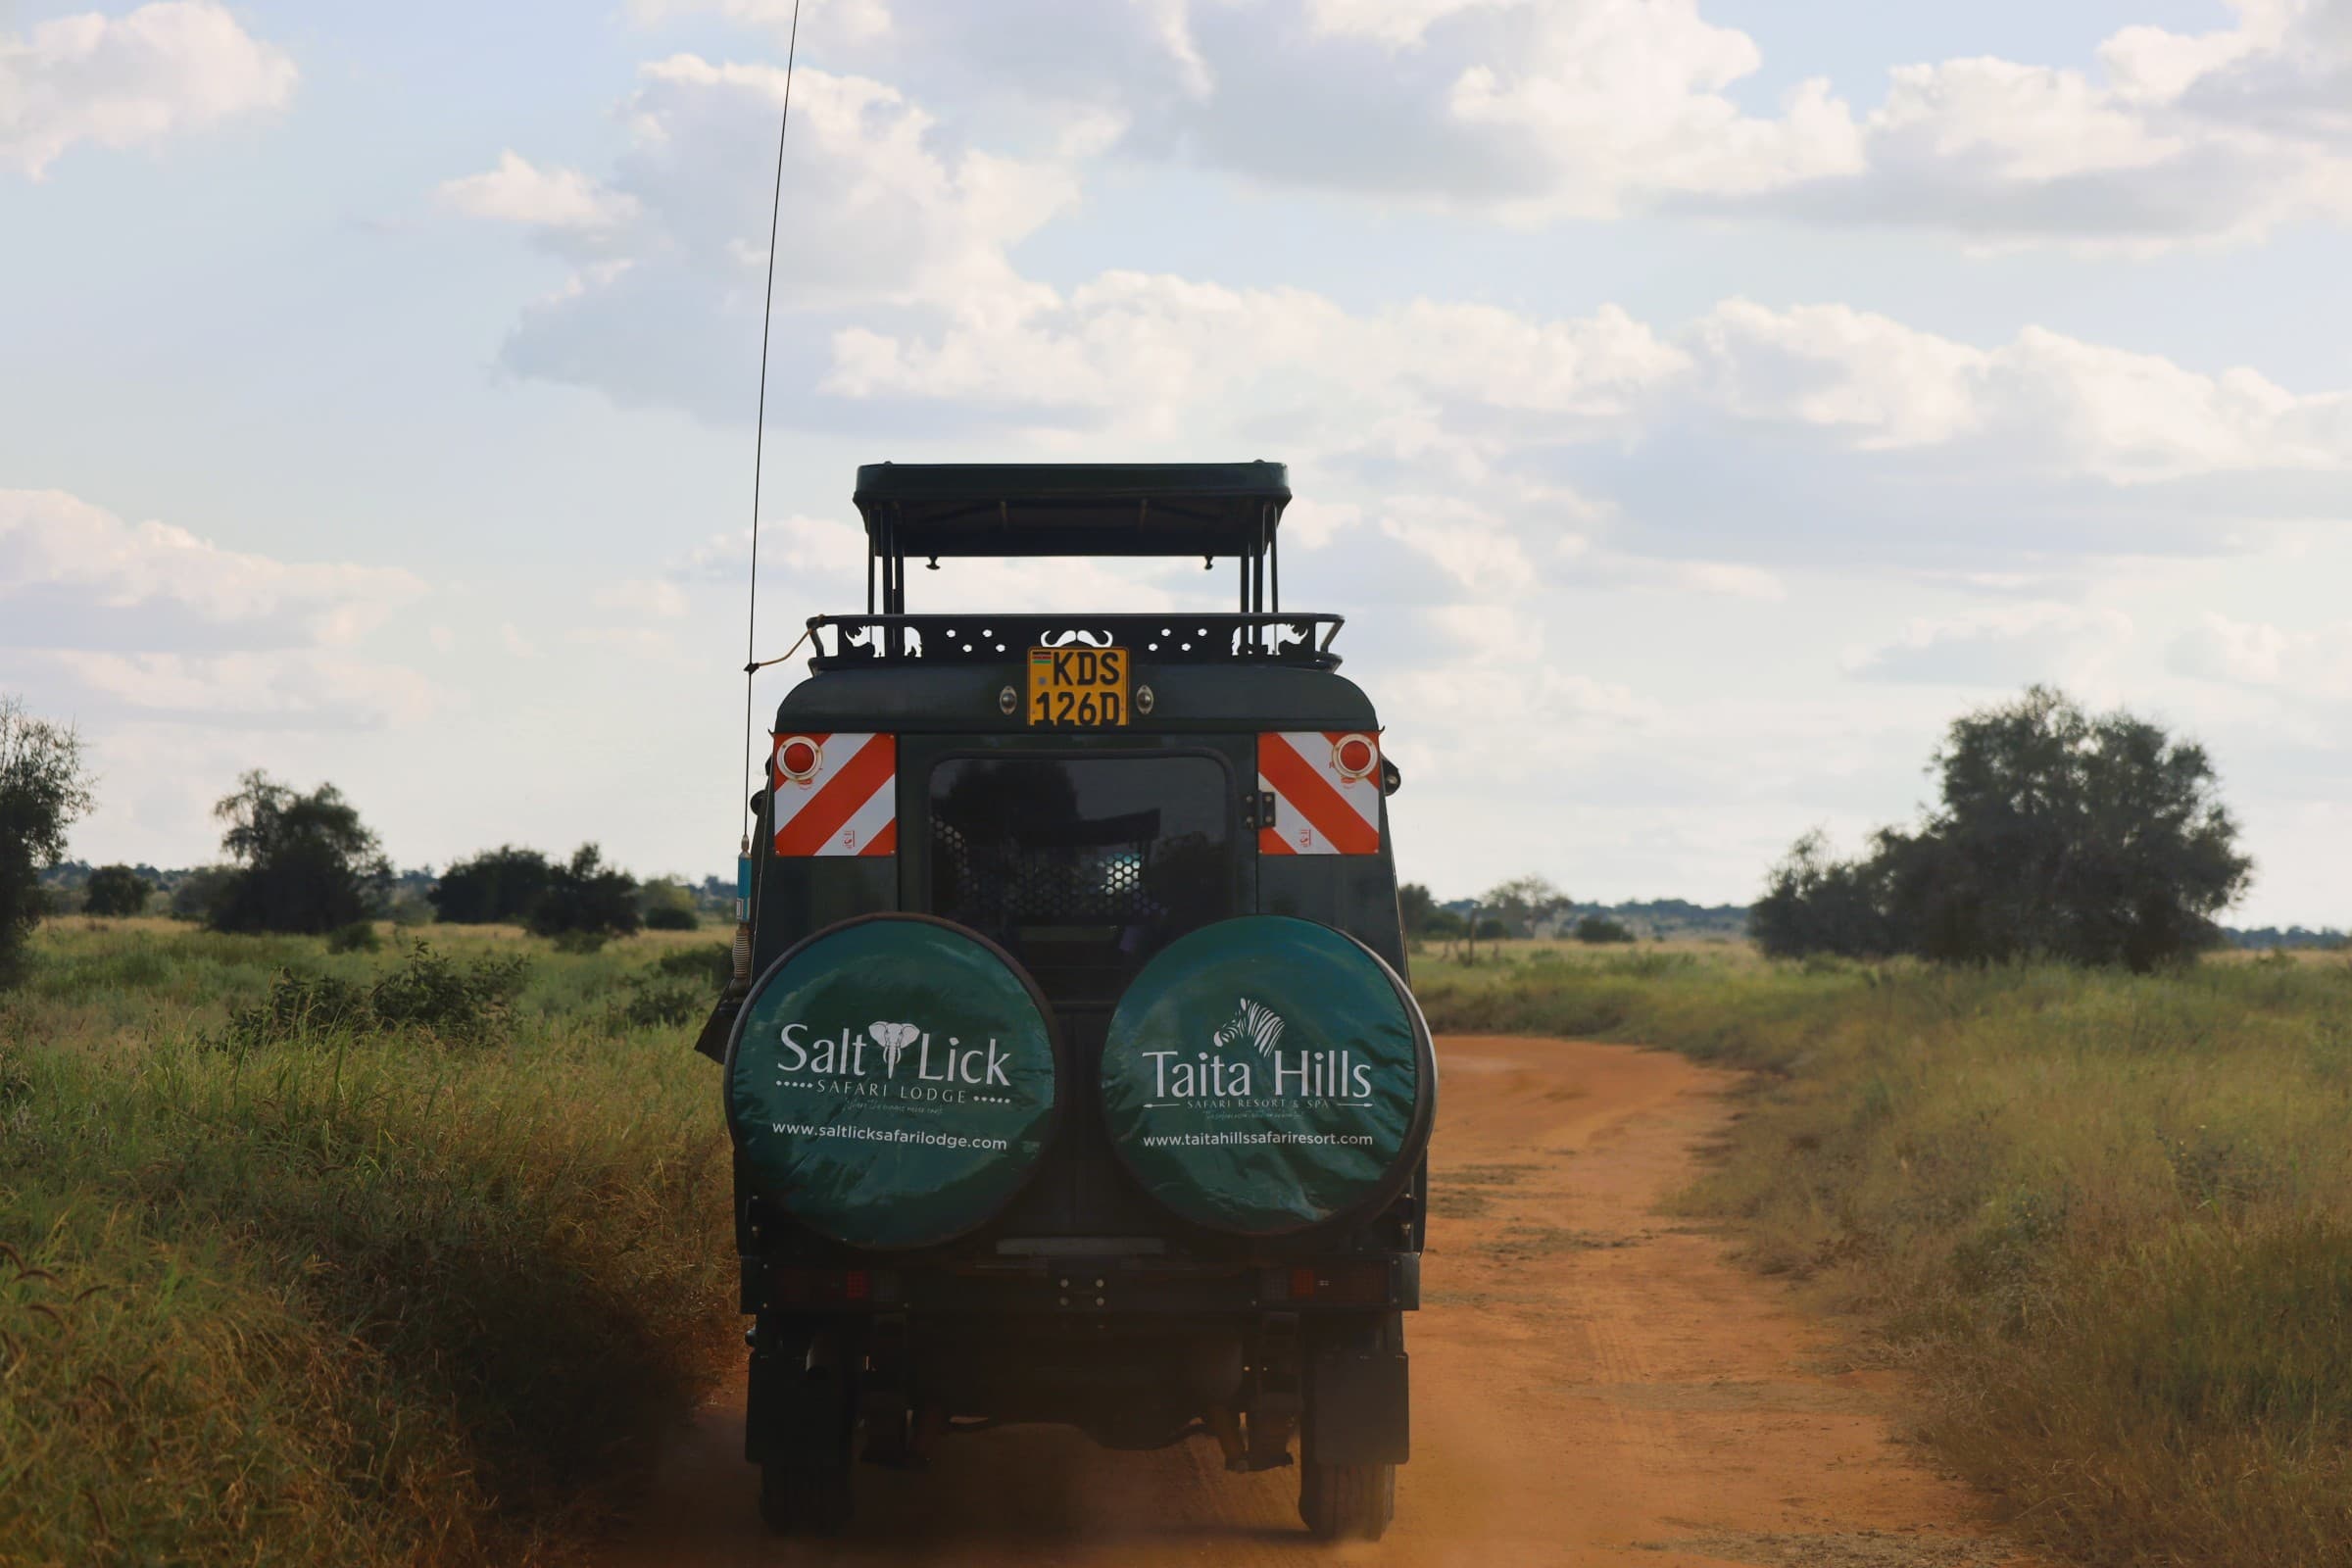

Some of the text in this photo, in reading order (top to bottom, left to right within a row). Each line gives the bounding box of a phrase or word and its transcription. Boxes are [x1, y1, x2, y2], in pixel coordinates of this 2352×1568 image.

[1054, 652, 1120, 685] KDS
[1036, 692, 1120, 725] 126D
[777, 1023, 1011, 1086] Salt Lick
[1142, 1050, 1371, 1098] Taita Hills
[816, 1080, 966, 1103] SAFARI LODGE
[1187, 1099, 1329, 1108] SAFARI RESORT & SPA
[772, 1122, 1007, 1151] www.saltlicksafarilodge.com
[1143, 1130, 1373, 1147] www.taitahillssafariresort.com
